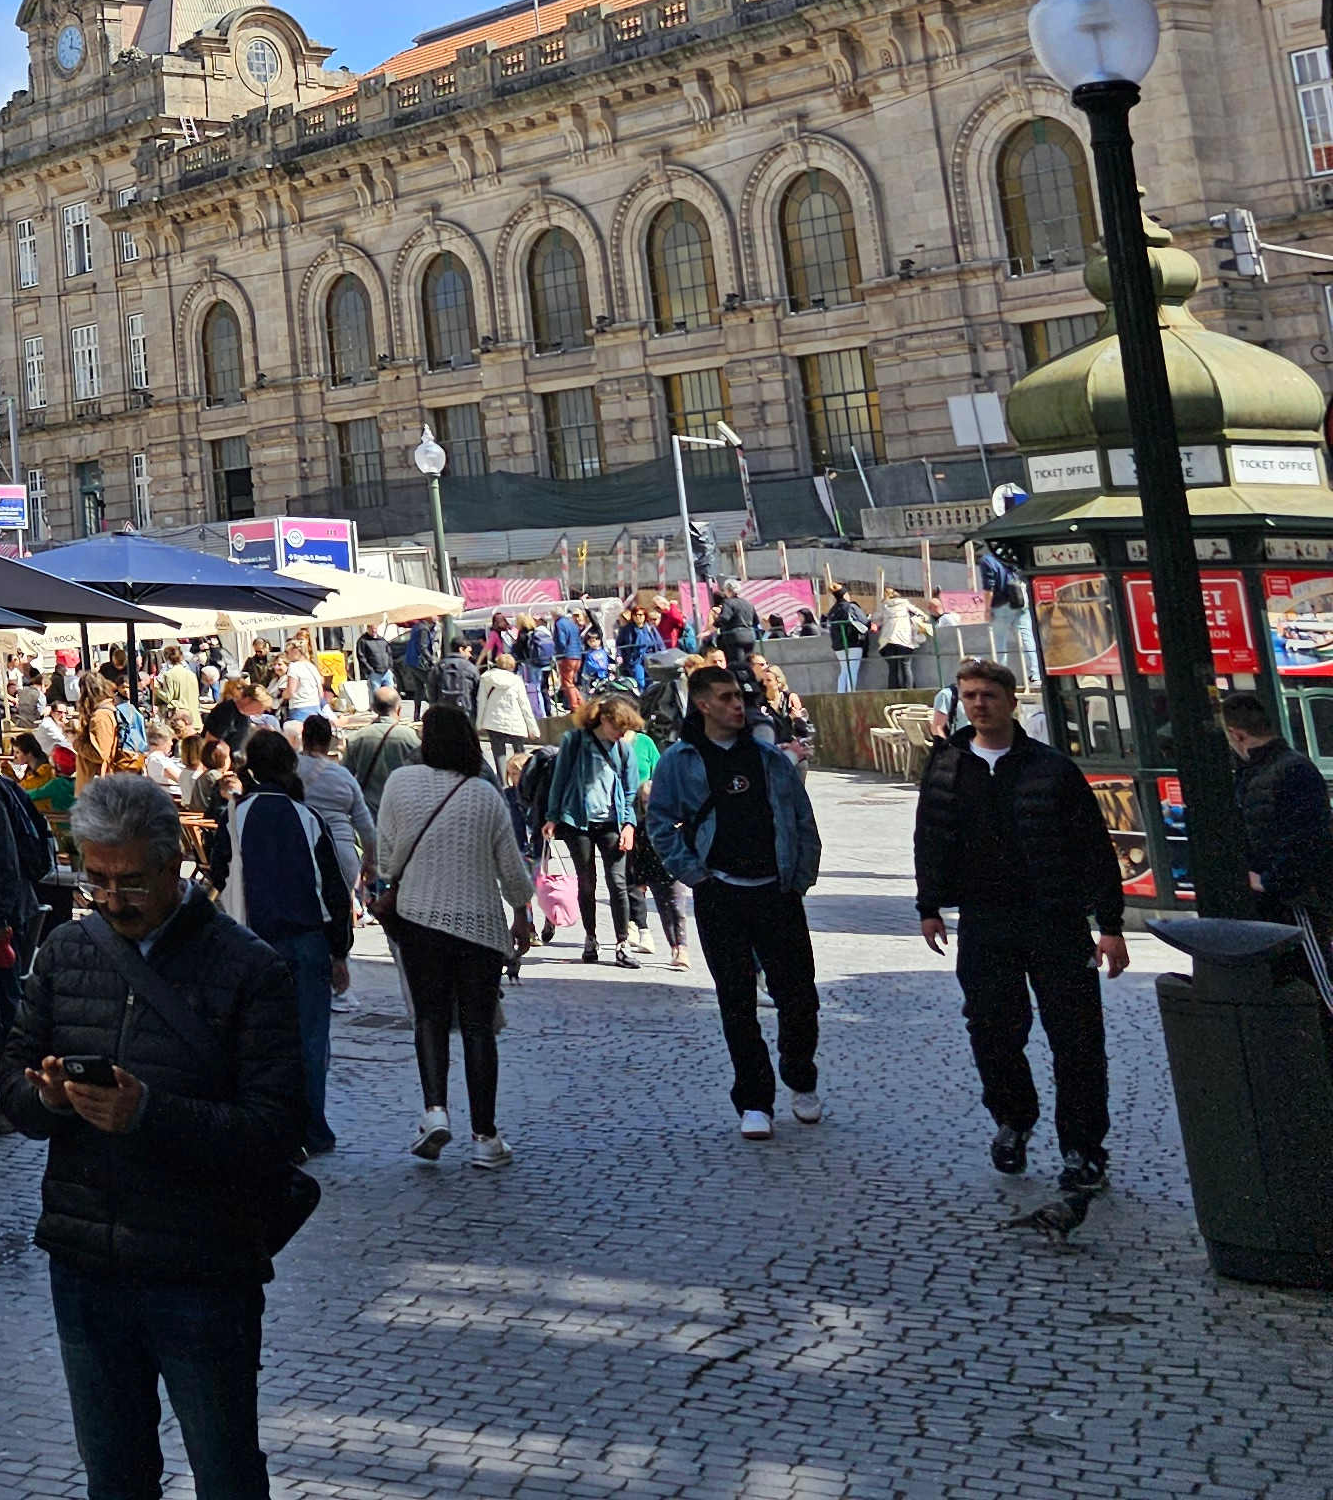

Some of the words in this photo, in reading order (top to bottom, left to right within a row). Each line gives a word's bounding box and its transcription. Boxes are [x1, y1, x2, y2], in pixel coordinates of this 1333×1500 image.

[1035, 468, 1062, 479] TICKET
[1066, 464, 1094, 476] OFFICE
[1239, 459, 1274, 470] TICKET
[1278, 461, 1313, 471] OFFICE
